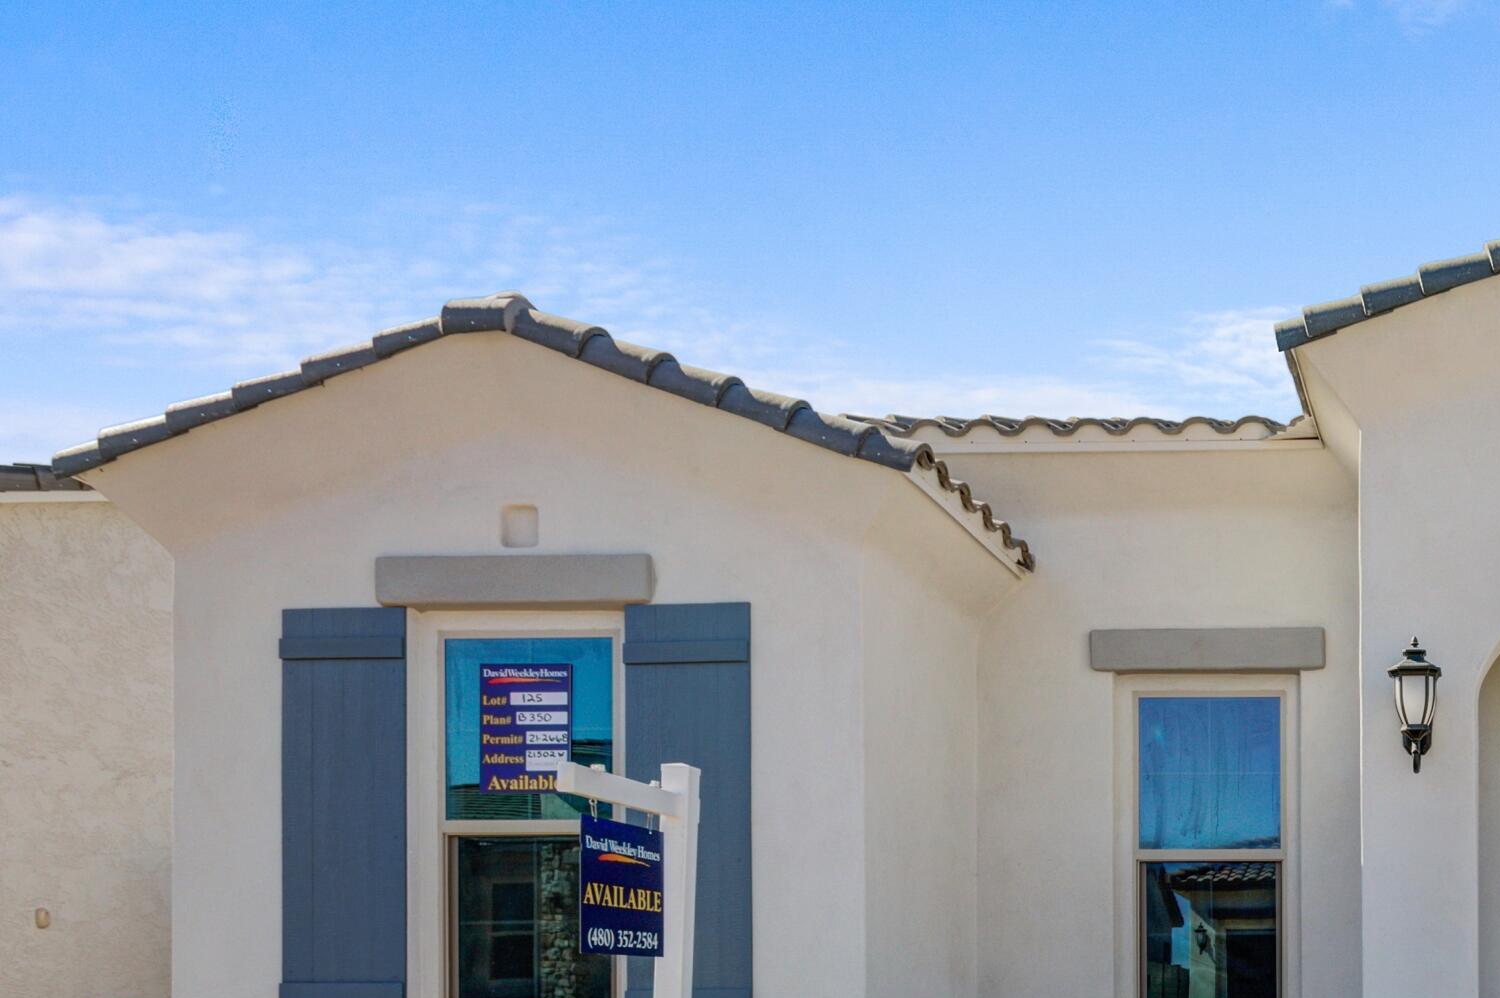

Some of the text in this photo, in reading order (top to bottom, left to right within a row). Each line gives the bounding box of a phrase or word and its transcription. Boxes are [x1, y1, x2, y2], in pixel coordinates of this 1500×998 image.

[482, 694, 543, 706] Lot# 125
[482, 714, 512, 725] Plan#
[482, 734, 523, 745] Permit#
[482, 754, 524, 764] Address
[585, 835, 608, 851] David
[637, 845, 660, 862] Homes
[583, 882, 662, 912] AVAILABLE
[587, 927, 659, 950] (480) 352-2584
